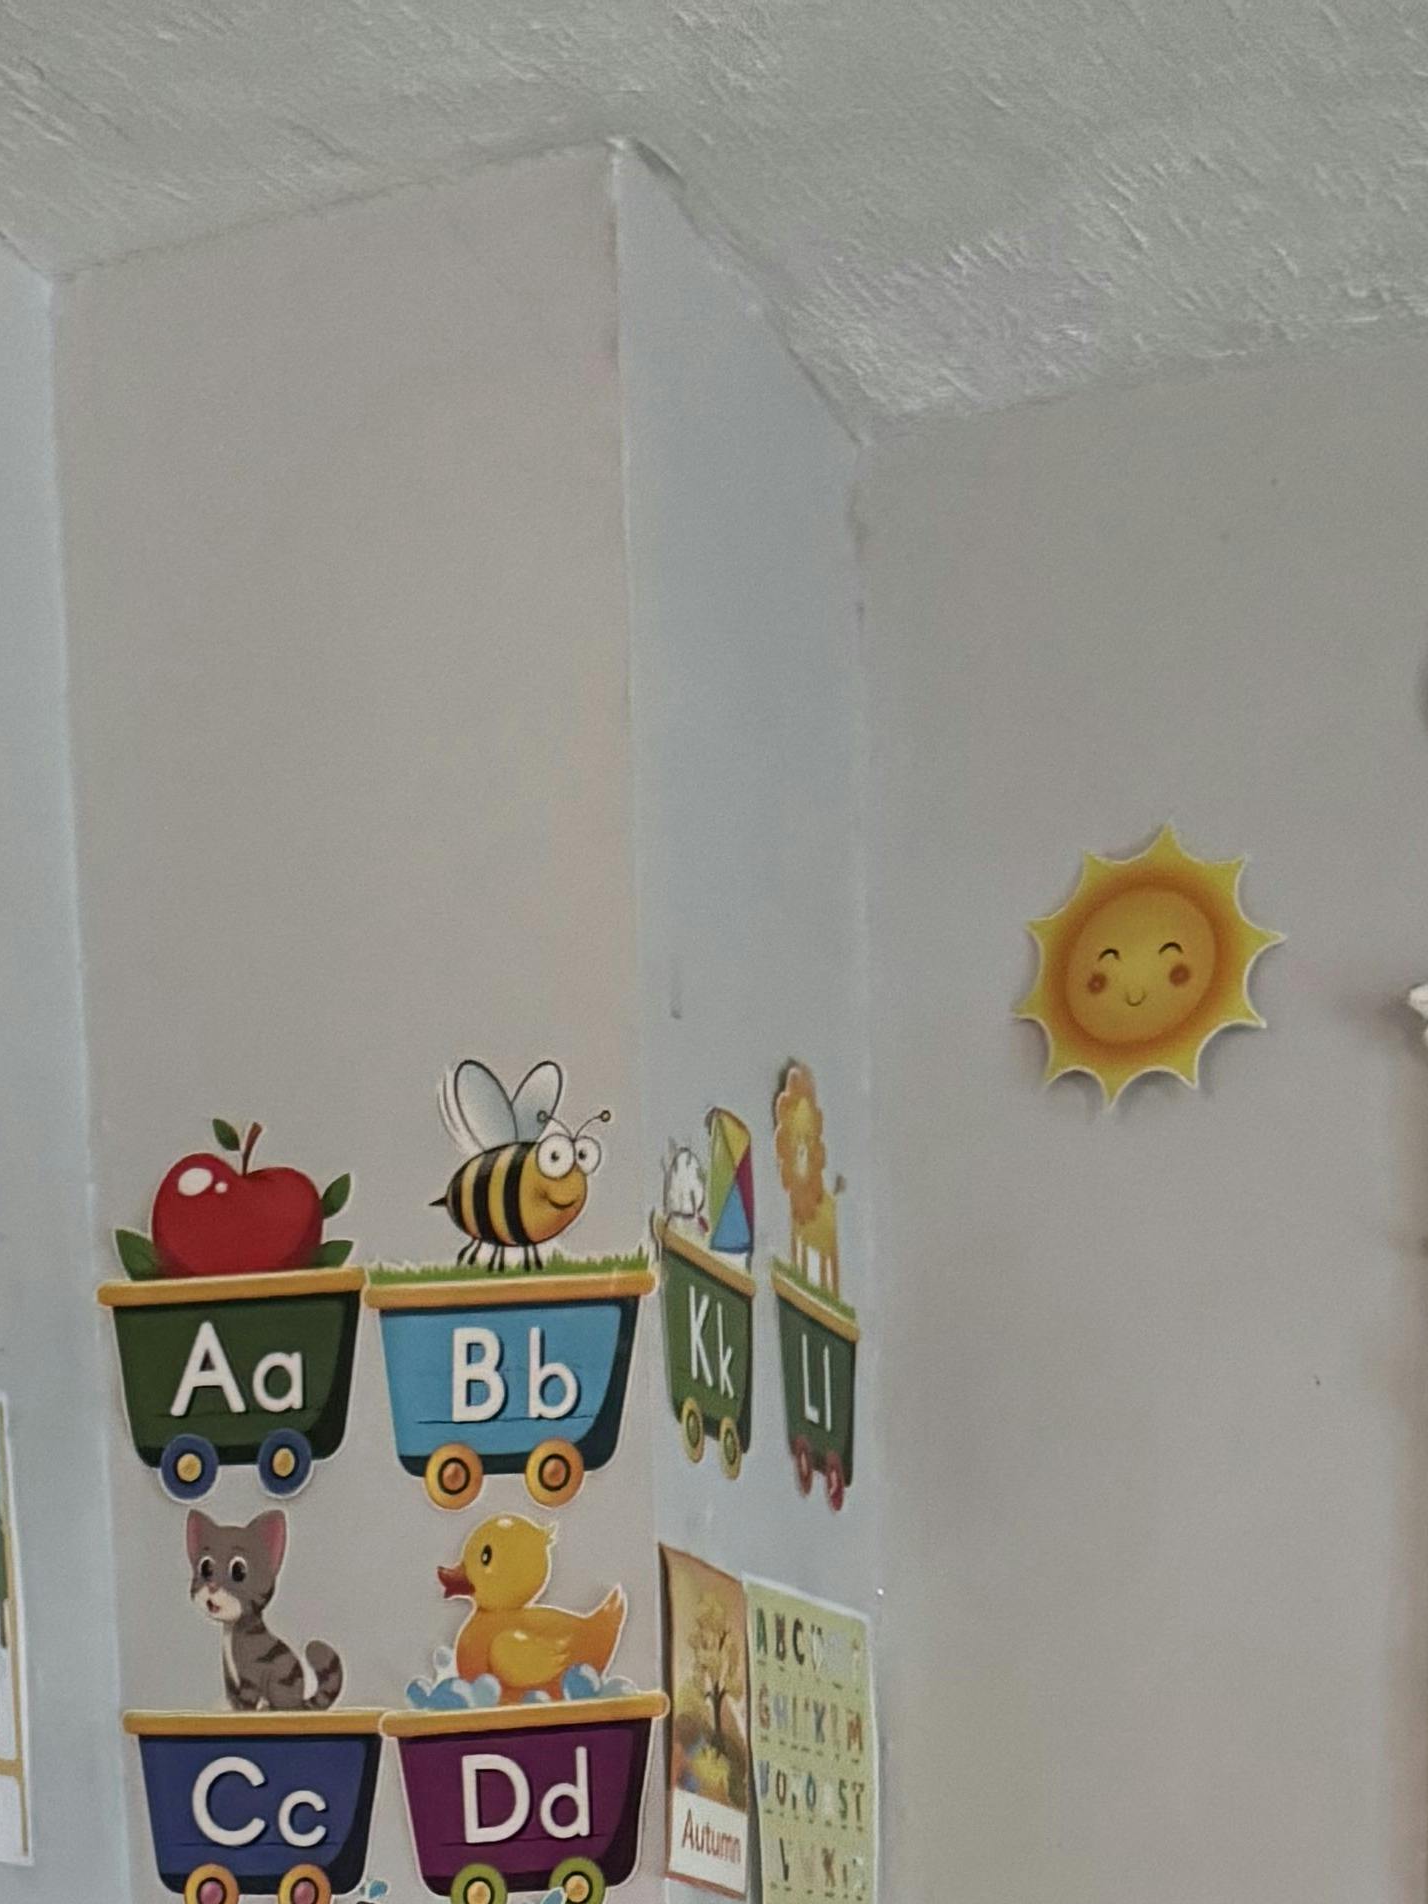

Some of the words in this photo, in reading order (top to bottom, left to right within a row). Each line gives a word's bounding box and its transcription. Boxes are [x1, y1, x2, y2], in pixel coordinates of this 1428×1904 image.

[170, 1321, 304, 1417] Aa
[451, 1327, 581, 1424] Bb
[689, 1285, 734, 1399] Kk
[801, 1333, 832, 1432] Ll
[191, 1756, 329, 1848] Cc
[461, 1746, 591, 1846] Dd
[682, 1808, 741, 1864] Autumn
